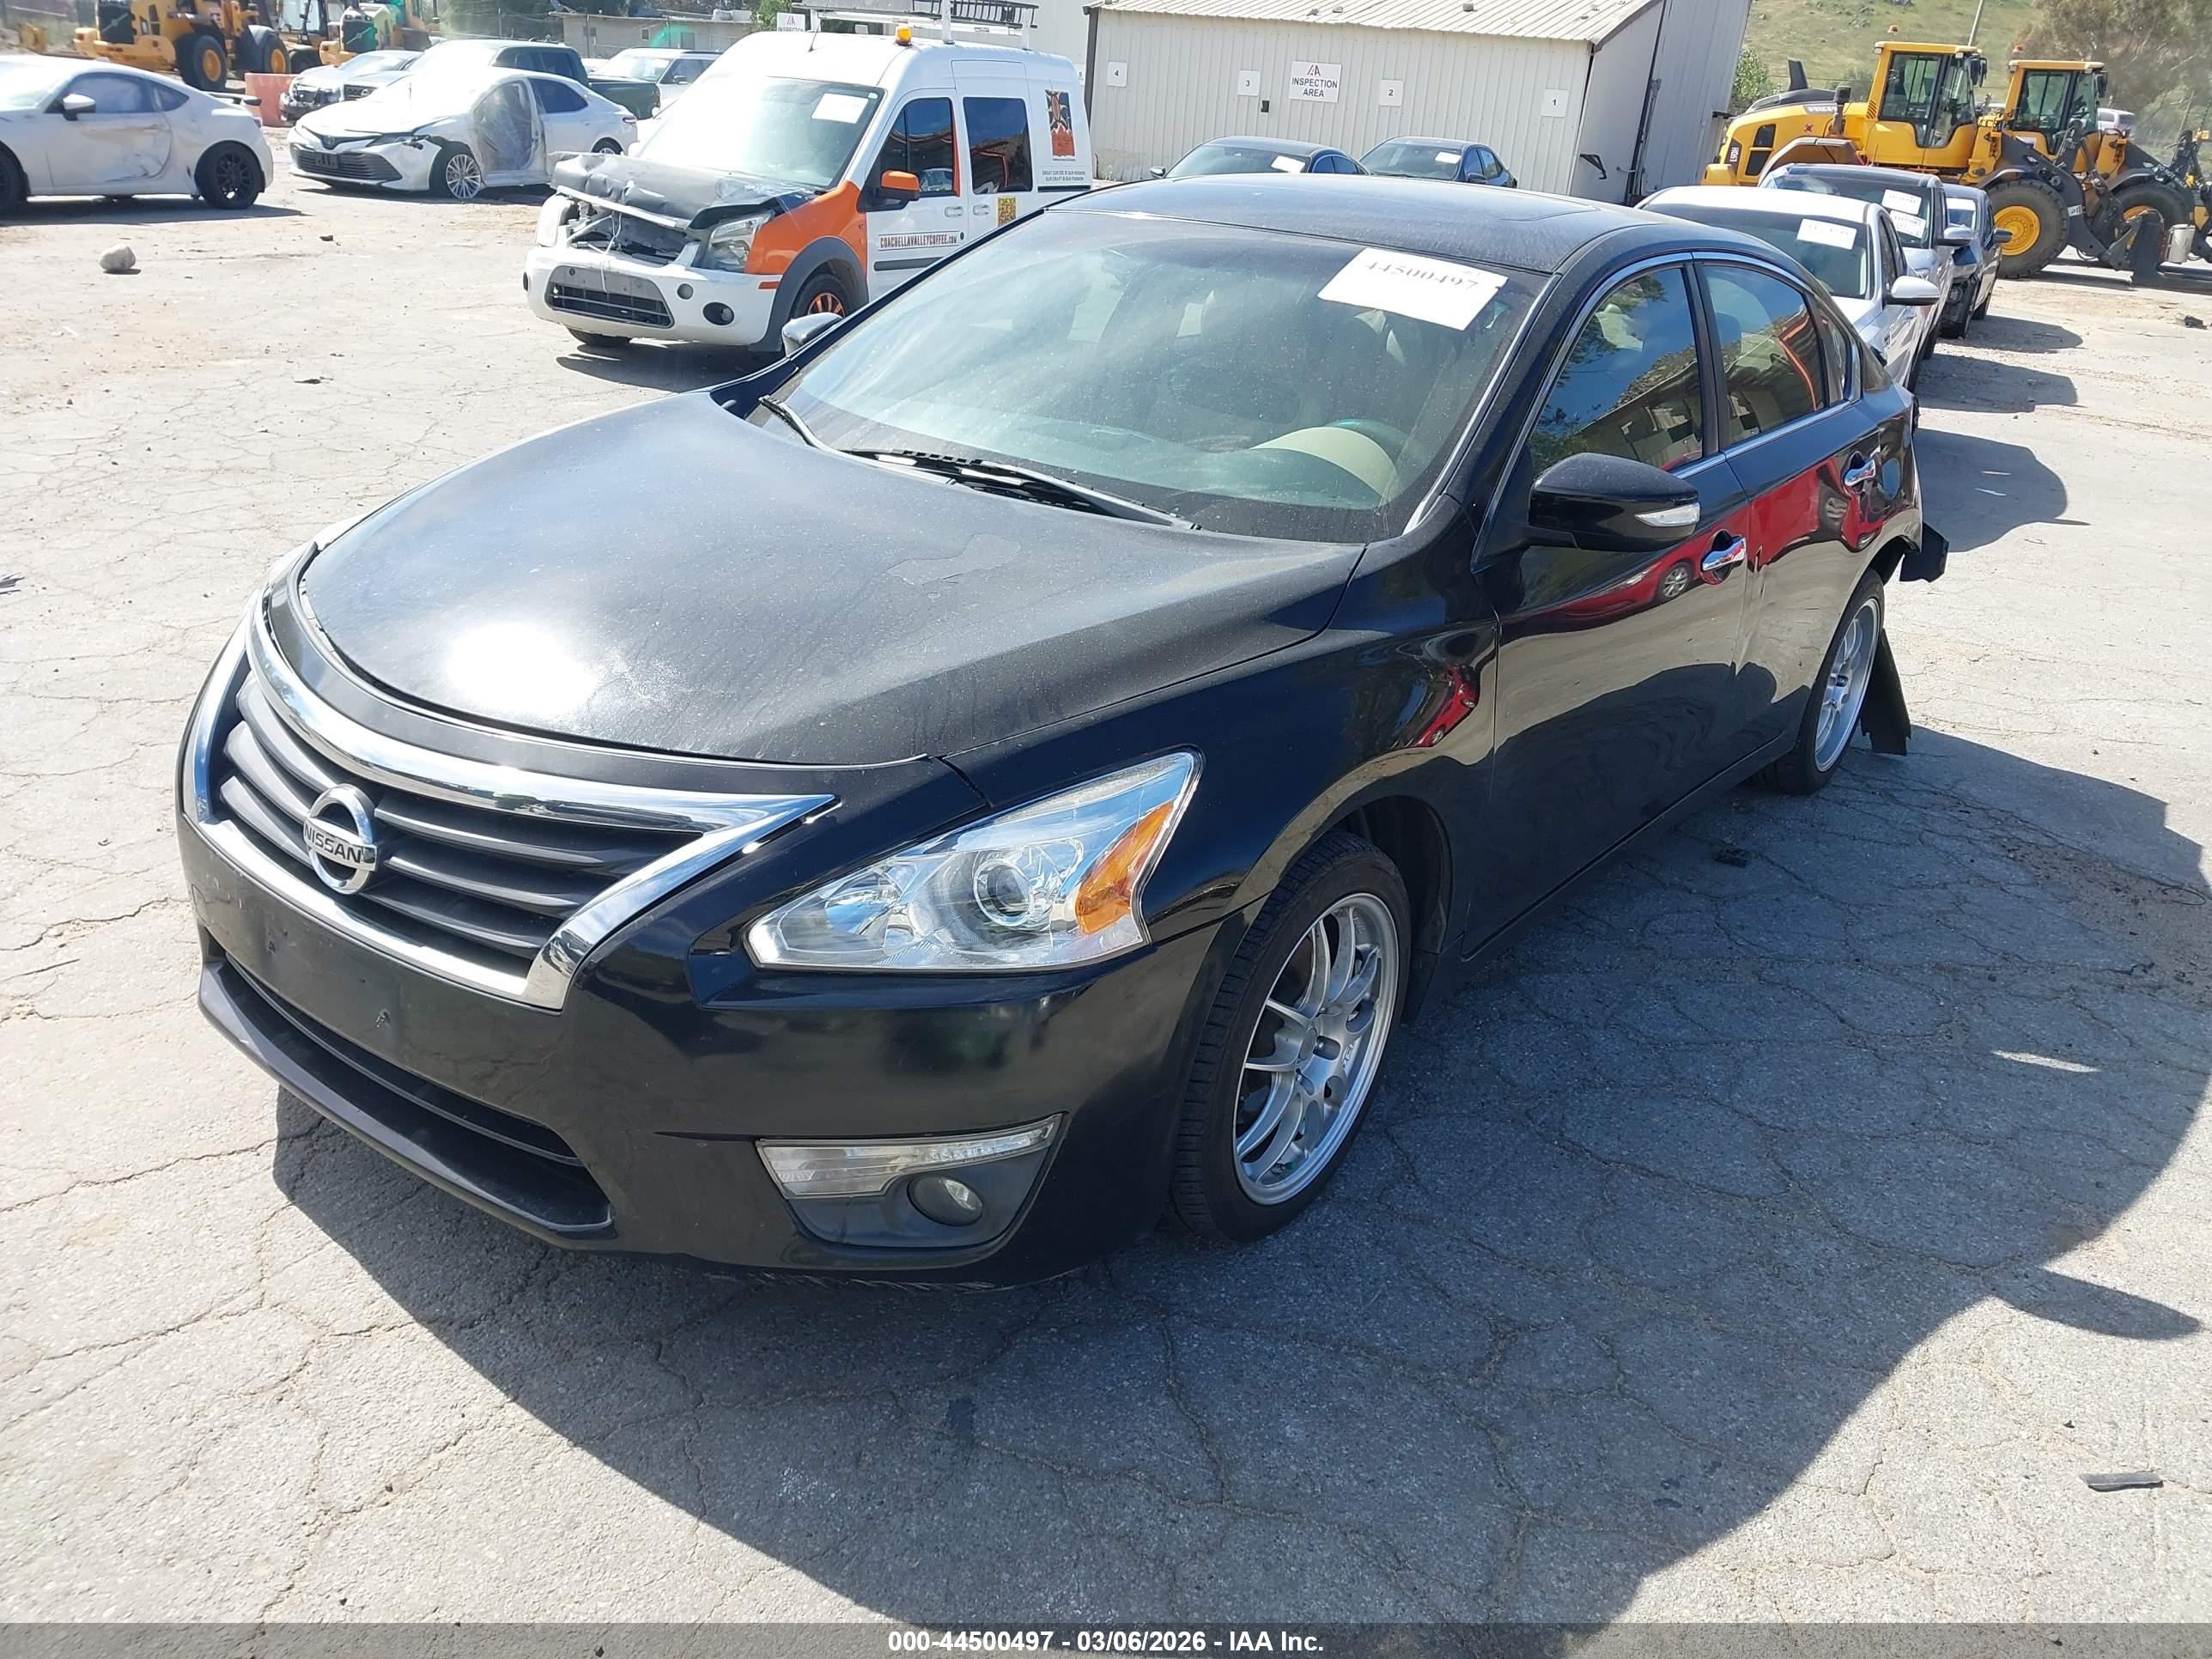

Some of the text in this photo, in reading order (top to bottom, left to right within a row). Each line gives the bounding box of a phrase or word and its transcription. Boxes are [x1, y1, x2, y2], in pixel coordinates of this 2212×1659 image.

[1291, 76, 1338, 88] INSPECTION
[1303, 88, 1325, 98] AREA
[304, 822, 361, 864] NISSAN
